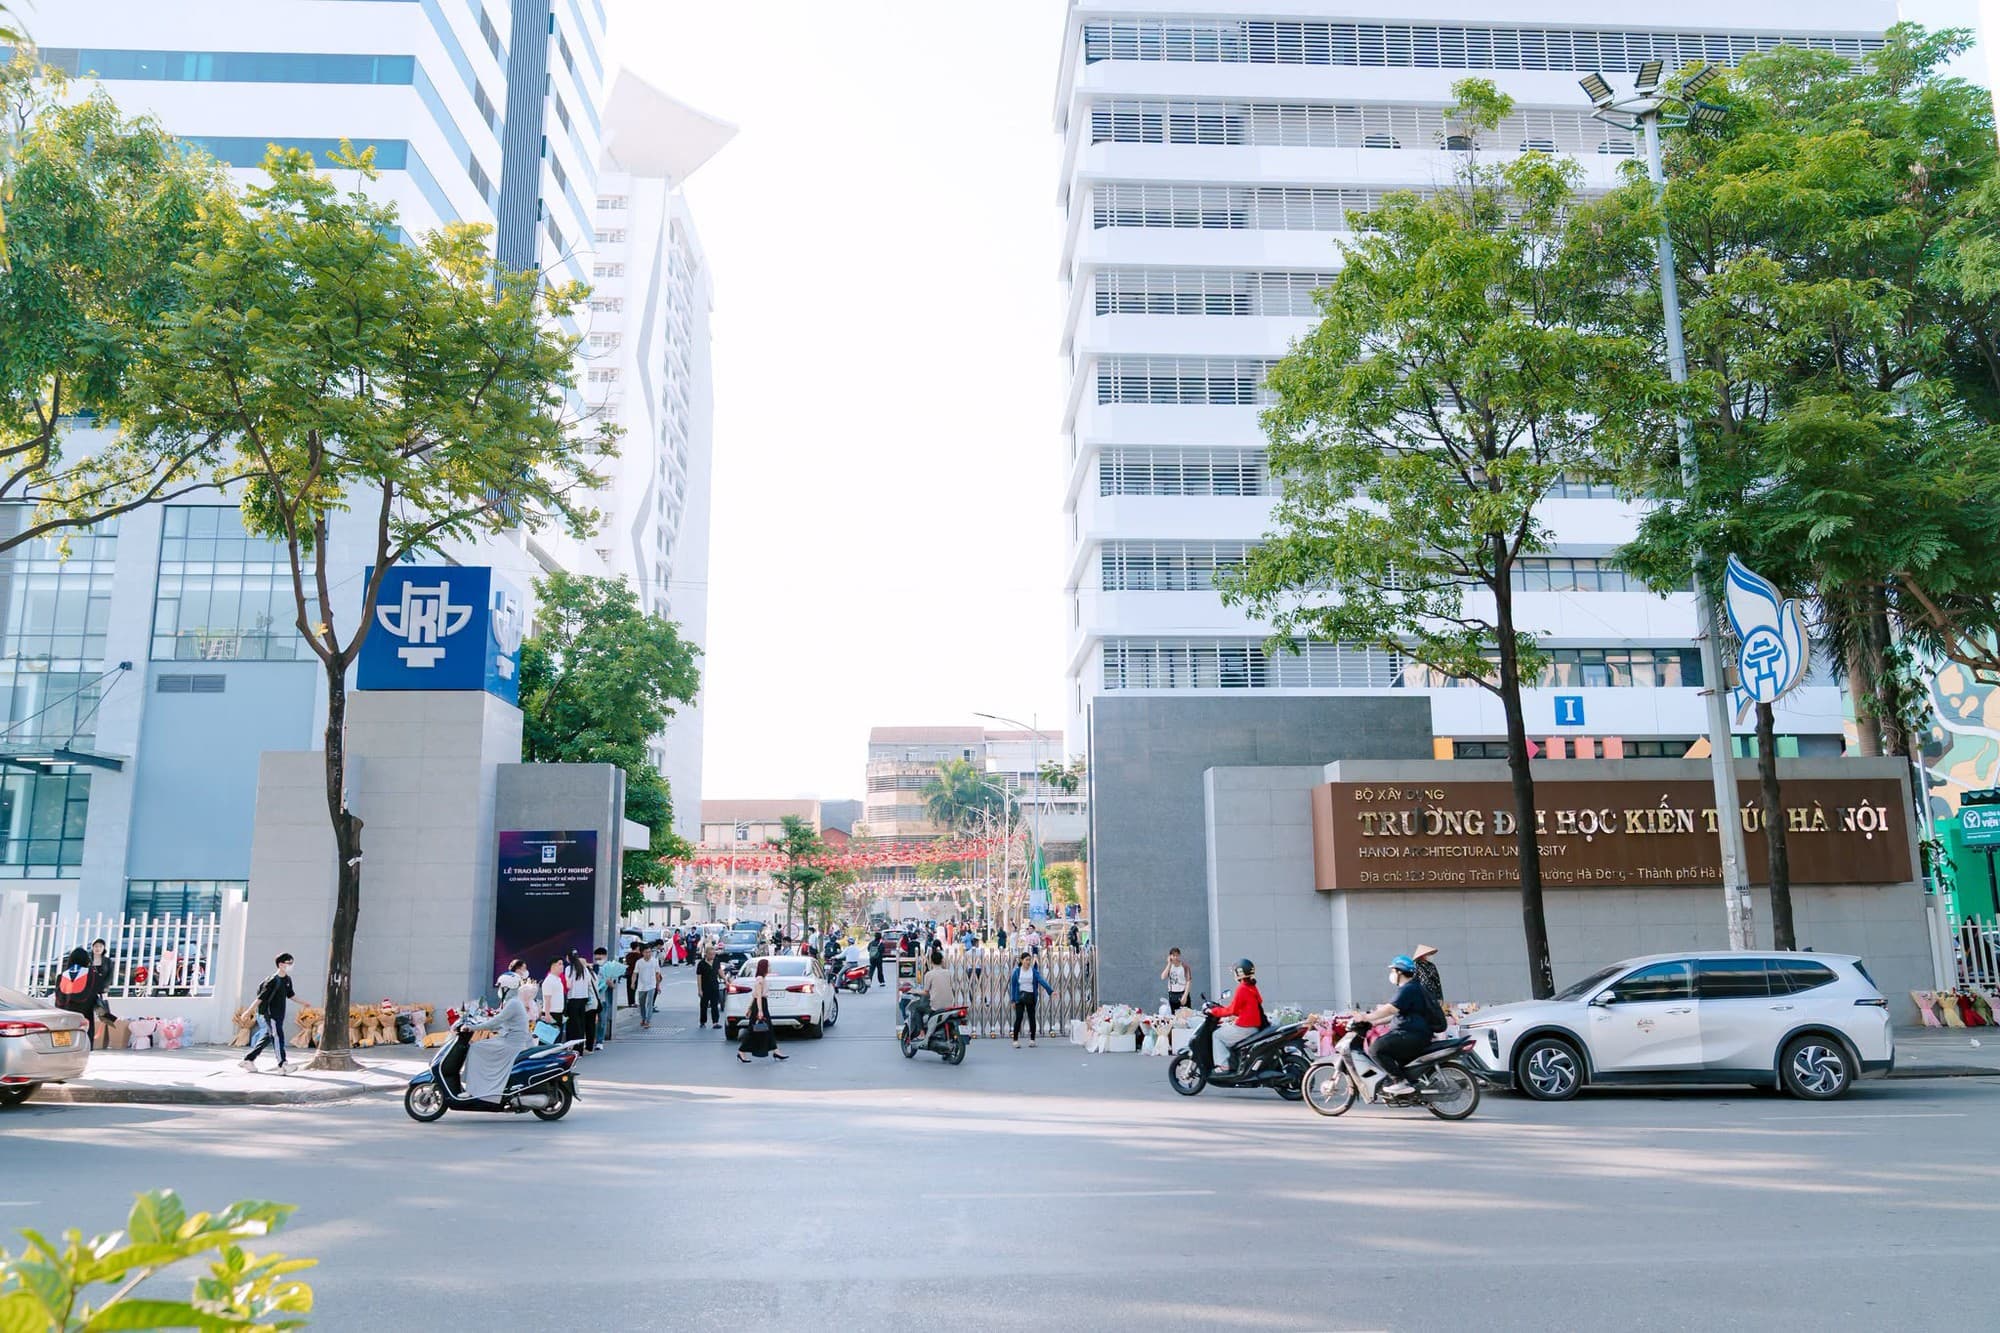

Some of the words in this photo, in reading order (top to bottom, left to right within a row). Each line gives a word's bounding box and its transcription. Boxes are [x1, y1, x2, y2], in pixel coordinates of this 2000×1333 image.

[1355, 787, 1374, 803] BỘ
[1377, 787, 1402, 800] XÂY
[1358, 804, 1485, 836] TRƯỜNG
[1493, 810, 1548, 835] ĐI
[1555, 808, 1617, 842] HỌC
[1624, 794, 1694, 834] KIẾN
[1701, 800, 1767, 833] TÚ
[1787, 800, 1831, 832] HÀ
[1836, 799, 1889, 840] NỘI
[1358, 847, 1400, 857] HANOI
[1402, 846, 1500, 857] ARCHITECTURAL
[1502, 845, 1567, 857] UNRSITY
[553, 866, 567, 874] TỐT
[1360, 871, 1380, 884] Địa
[1427, 869, 1466, 884] Đường
[1469, 868, 1495, 881] Trần
[1498, 868, 1520, 881] Phú
[1576, 866, 1592, 879] Hà
[1637, 865, 1673, 879] Thành
[1676, 865, 1697, 880] phố
[1700, 865, 1715, 878] Hà
